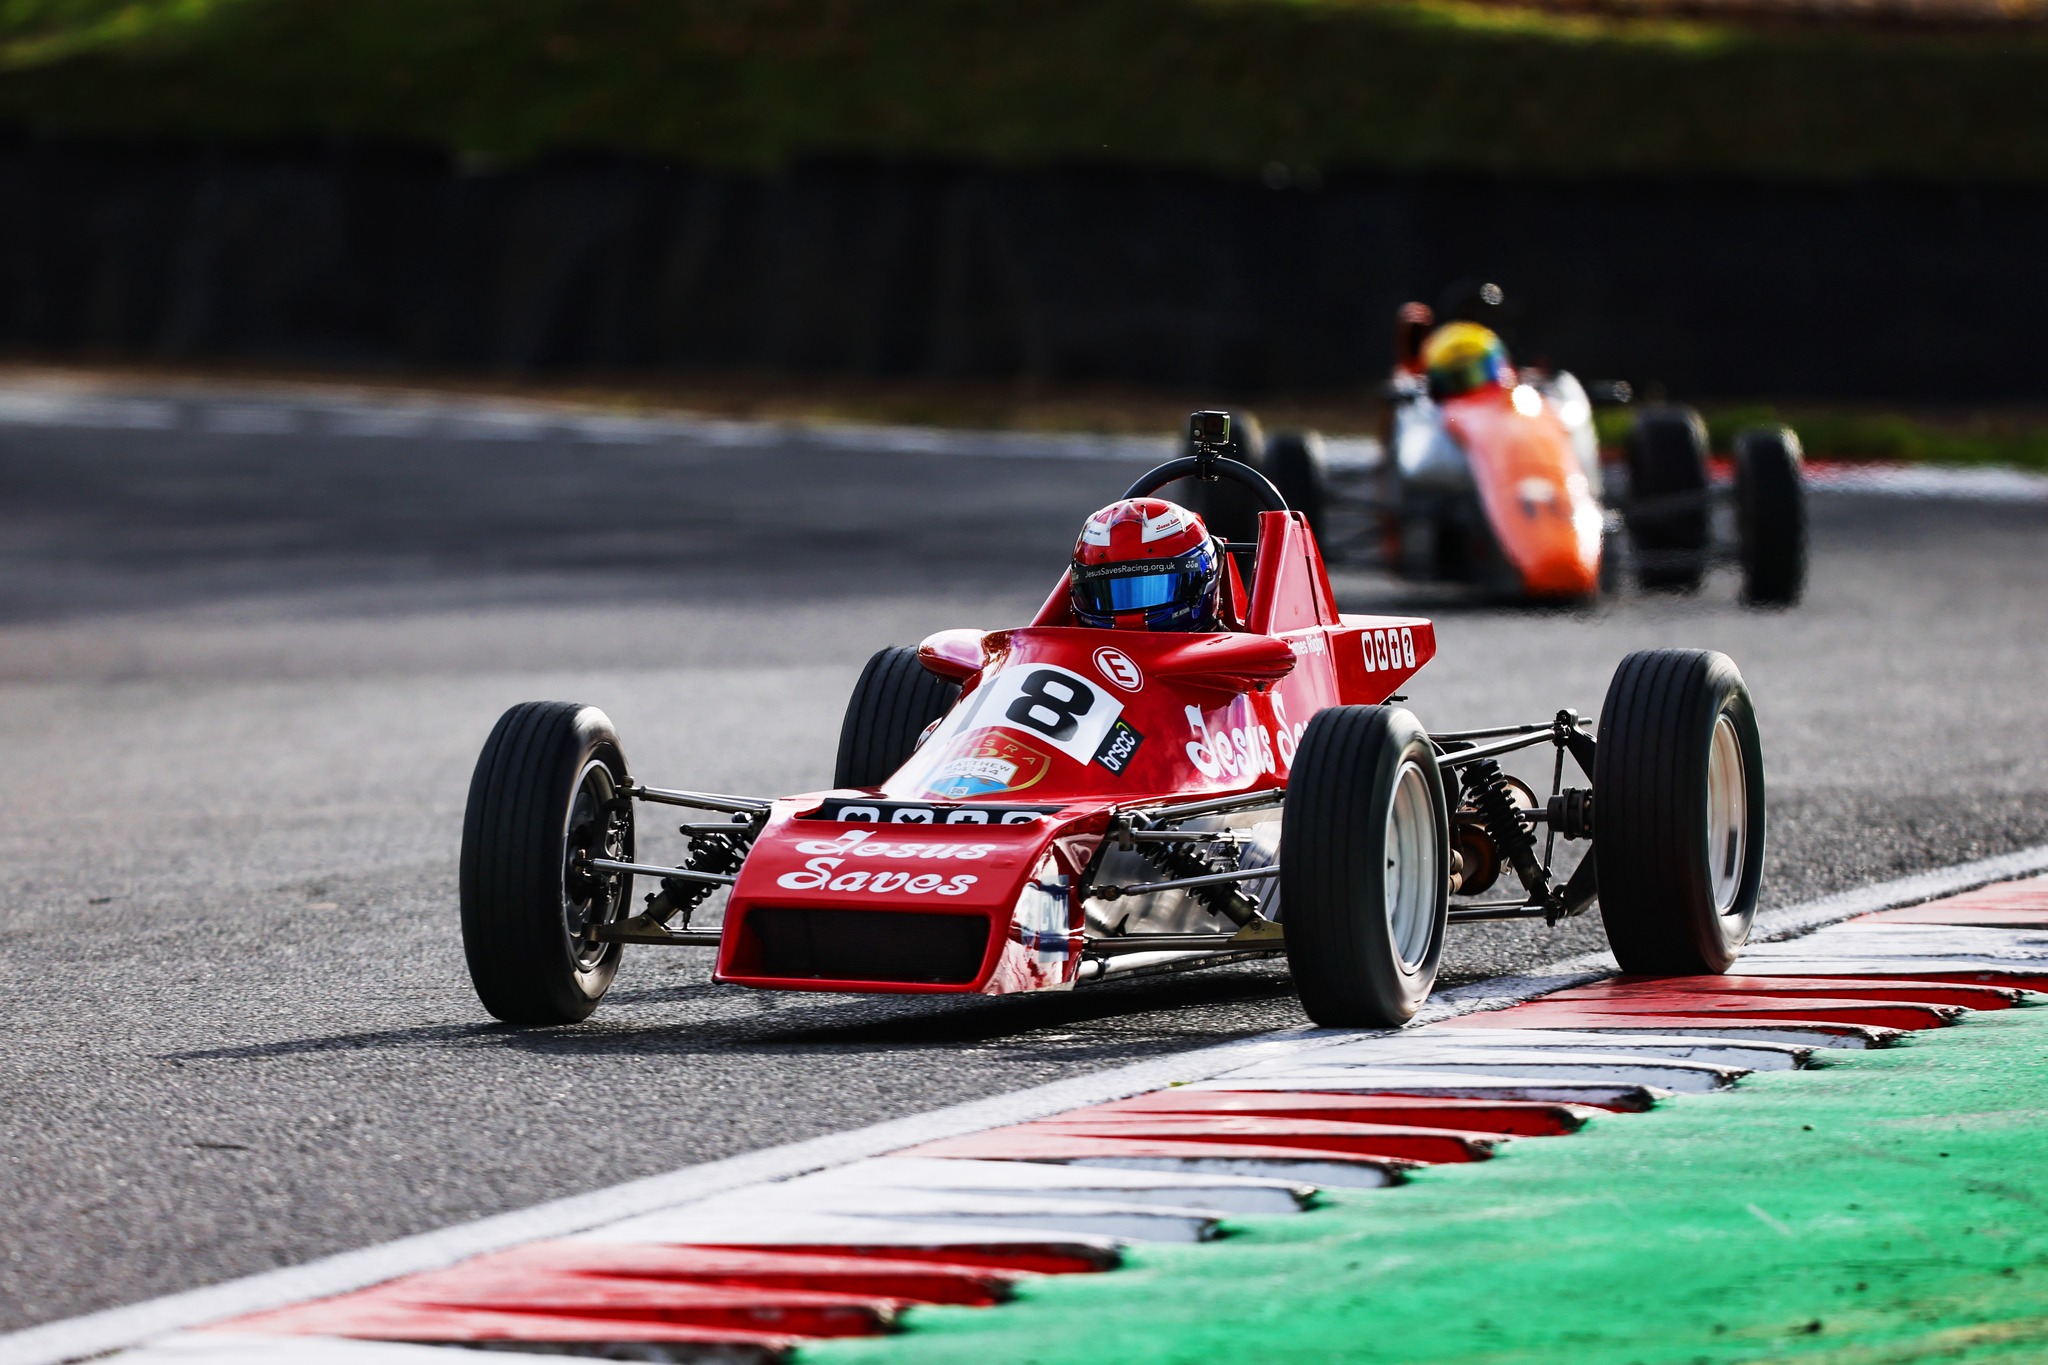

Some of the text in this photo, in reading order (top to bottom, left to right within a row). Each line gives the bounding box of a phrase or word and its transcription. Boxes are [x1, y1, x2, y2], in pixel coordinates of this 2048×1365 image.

[1085, 562, 1175, 578] JesusSavesRacing.org.uk
[1102, 654, 1134, 682] E
[1097, 730, 1136, 771] brscc
[1184, 703, 1276, 779] Jesus
[795, 829, 997, 860] Jesus
[777, 856, 978, 896] Saves
